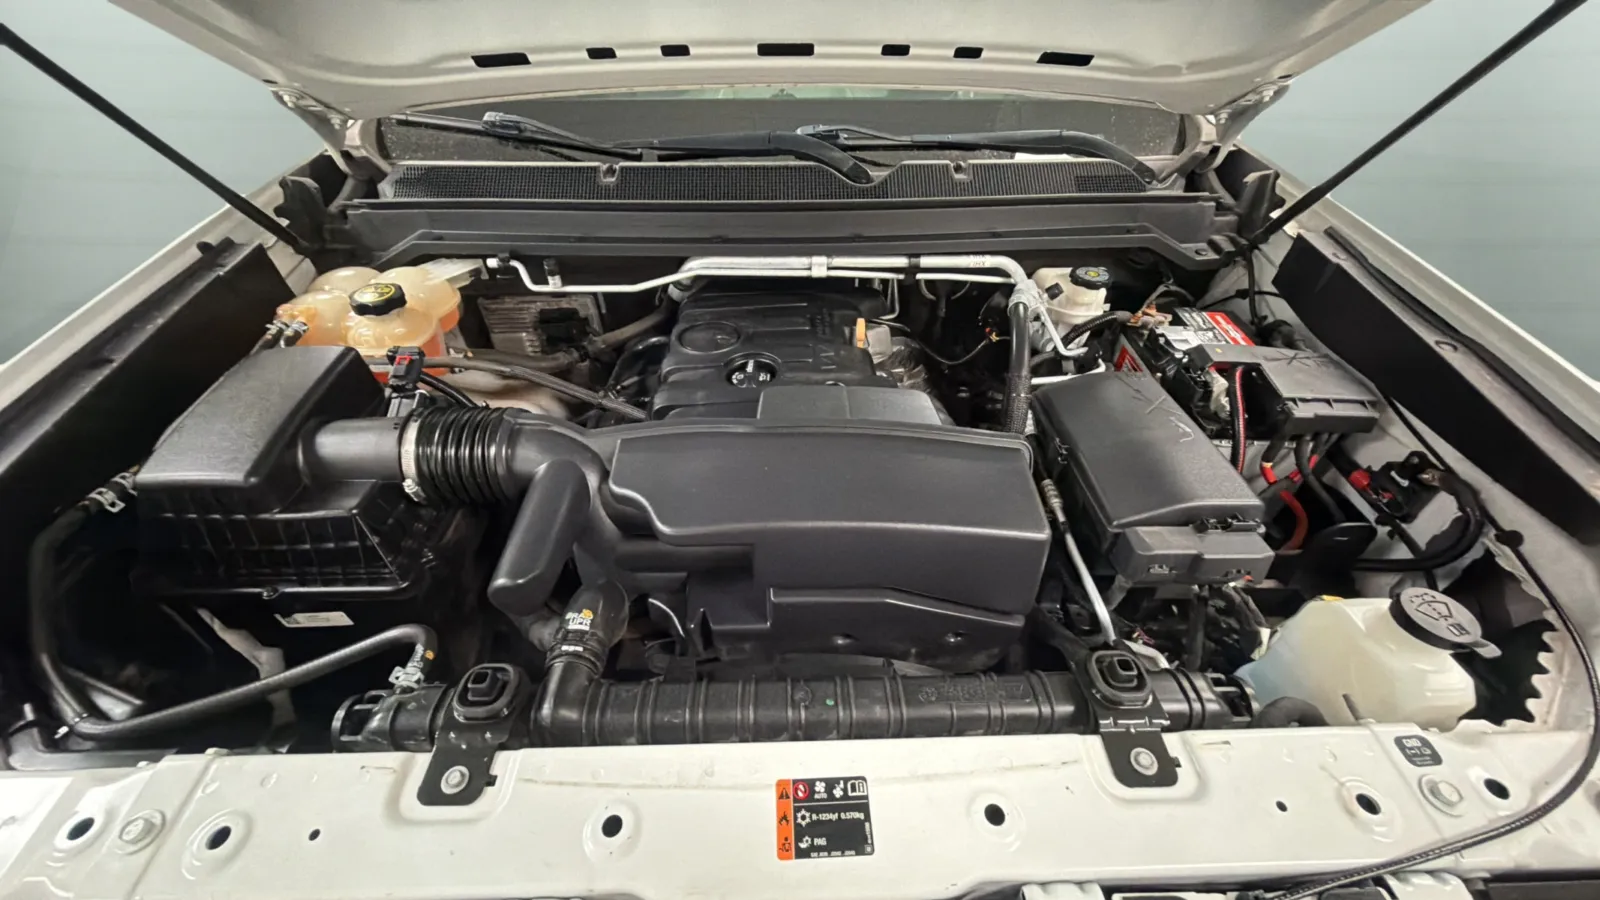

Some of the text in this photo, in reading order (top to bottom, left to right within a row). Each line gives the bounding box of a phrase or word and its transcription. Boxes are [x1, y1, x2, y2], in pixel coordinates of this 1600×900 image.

[811, 811, 864, 821] R-1234yf 0.570kg
[813, 837, 827, 846] PAG
